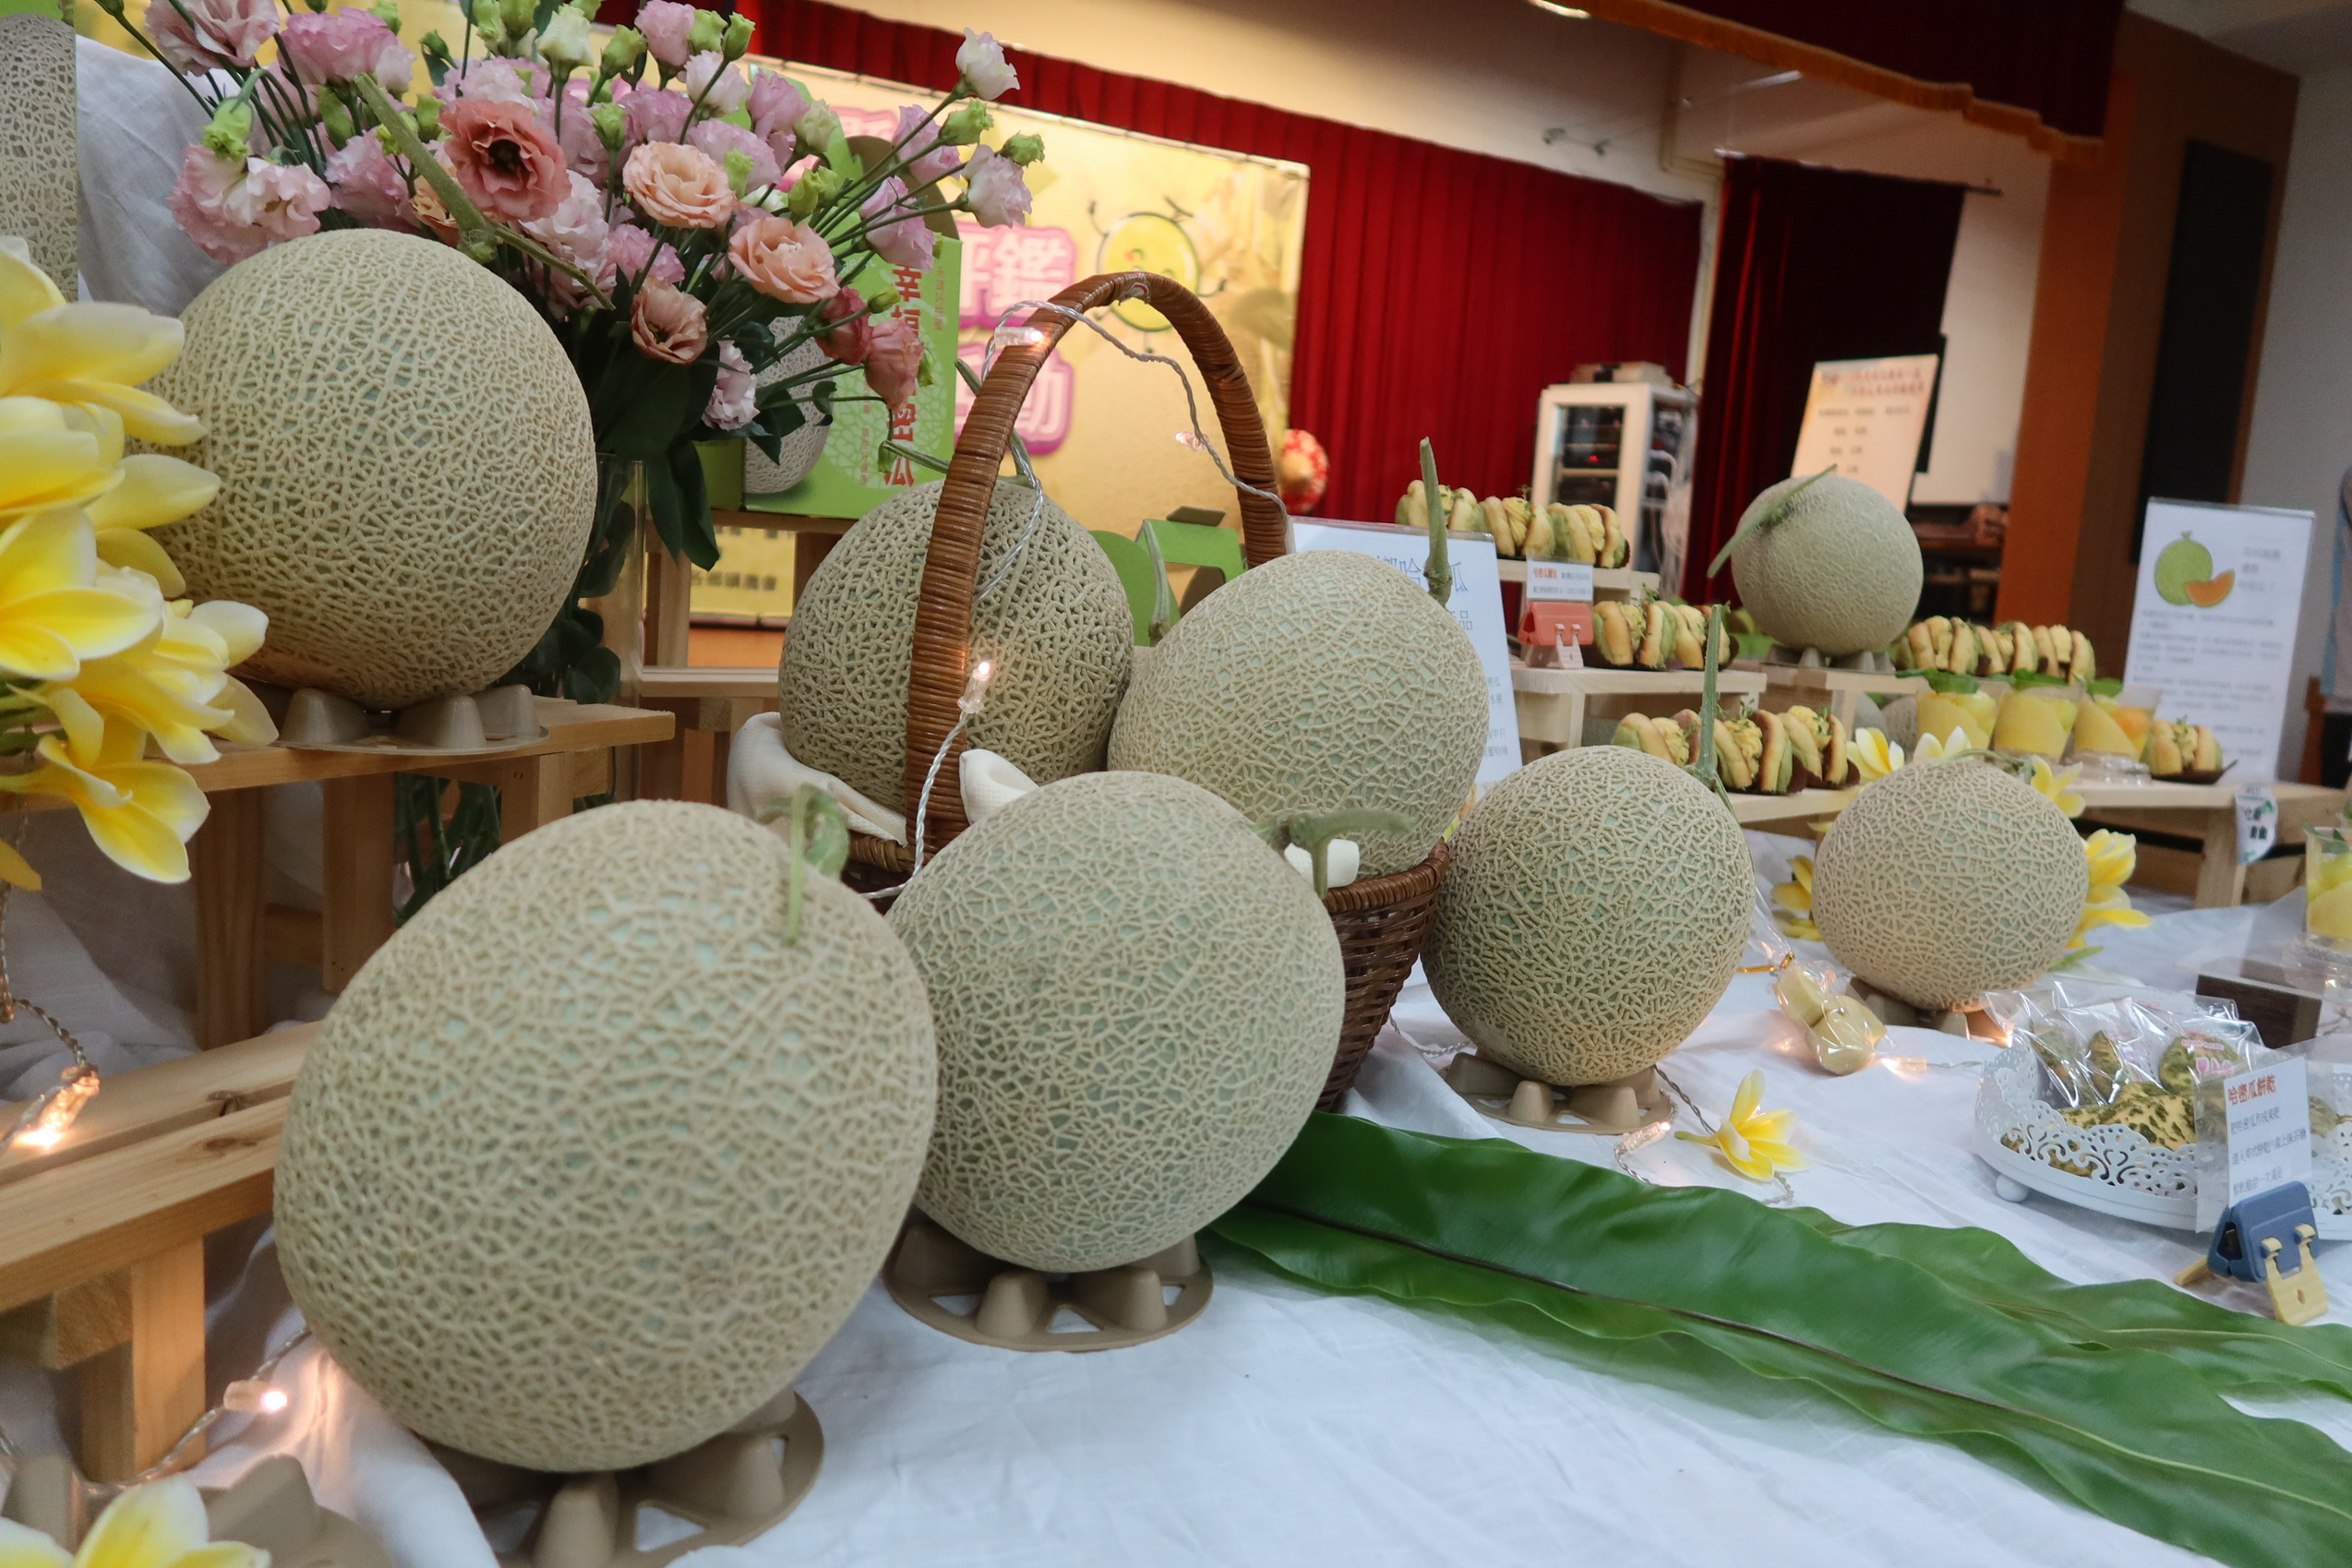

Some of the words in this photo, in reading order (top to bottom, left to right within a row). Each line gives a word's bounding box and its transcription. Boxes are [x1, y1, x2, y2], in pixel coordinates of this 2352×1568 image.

[883, 263, 922, 487] 幸福密瓜
[2228, 1074, 2276, 1106] 哈密瓜餅乾
